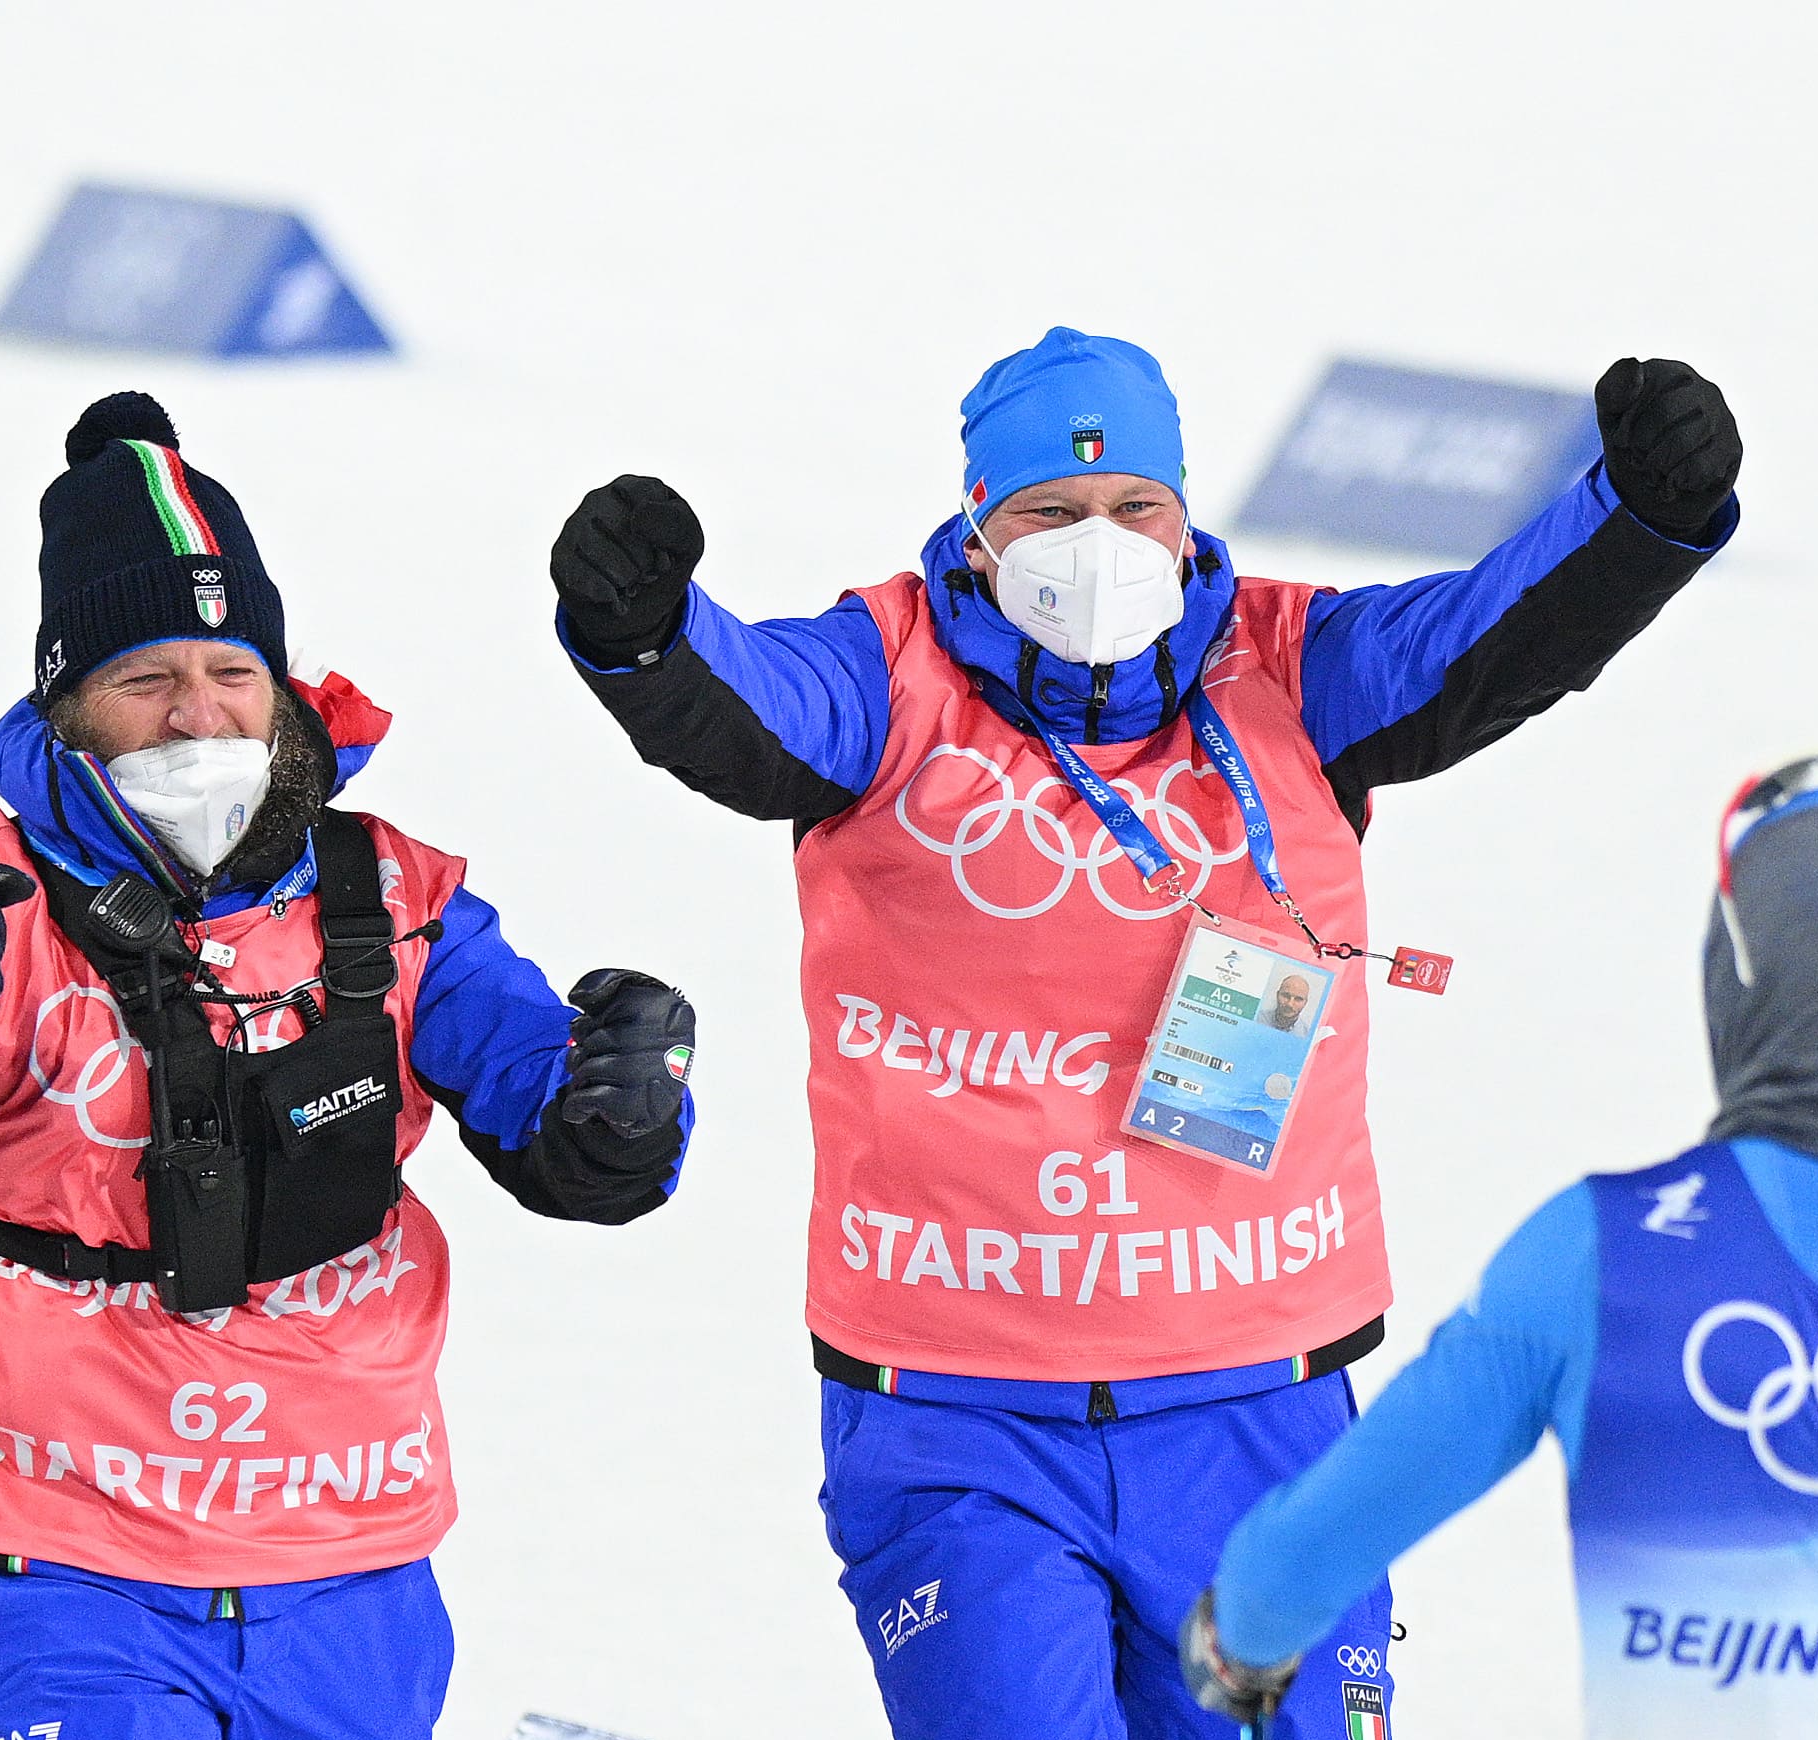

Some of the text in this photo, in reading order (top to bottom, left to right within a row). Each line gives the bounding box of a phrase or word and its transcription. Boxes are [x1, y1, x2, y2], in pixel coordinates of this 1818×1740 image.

[1079, 777, 1111, 806] 2022
[1200, 720, 1257, 810] BEIJING 2022
[1210, 987, 1231, 1003] Ao
[834, 992, 1111, 1098] BEIJING
[303, 1075, 386, 1123] SAITEL
[1157, 1072, 1173, 1084] ALL
[296, 1091, 387, 1136] TELECOMUNICAZIONI
[1140, 1107, 1266, 1163] A 2 R
[1036, 1149, 1140, 1218] 61
[840, 1184, 1346, 1305] START/FINISH
[260, 1228, 418, 1321] 2022
[169, 1381, 268, 1443] 62
[877, 1578, 941, 1650] EA7
[1346, 1687, 1380, 1704] ITALIA
[1355, 1700, 1377, 1709] TEAM
